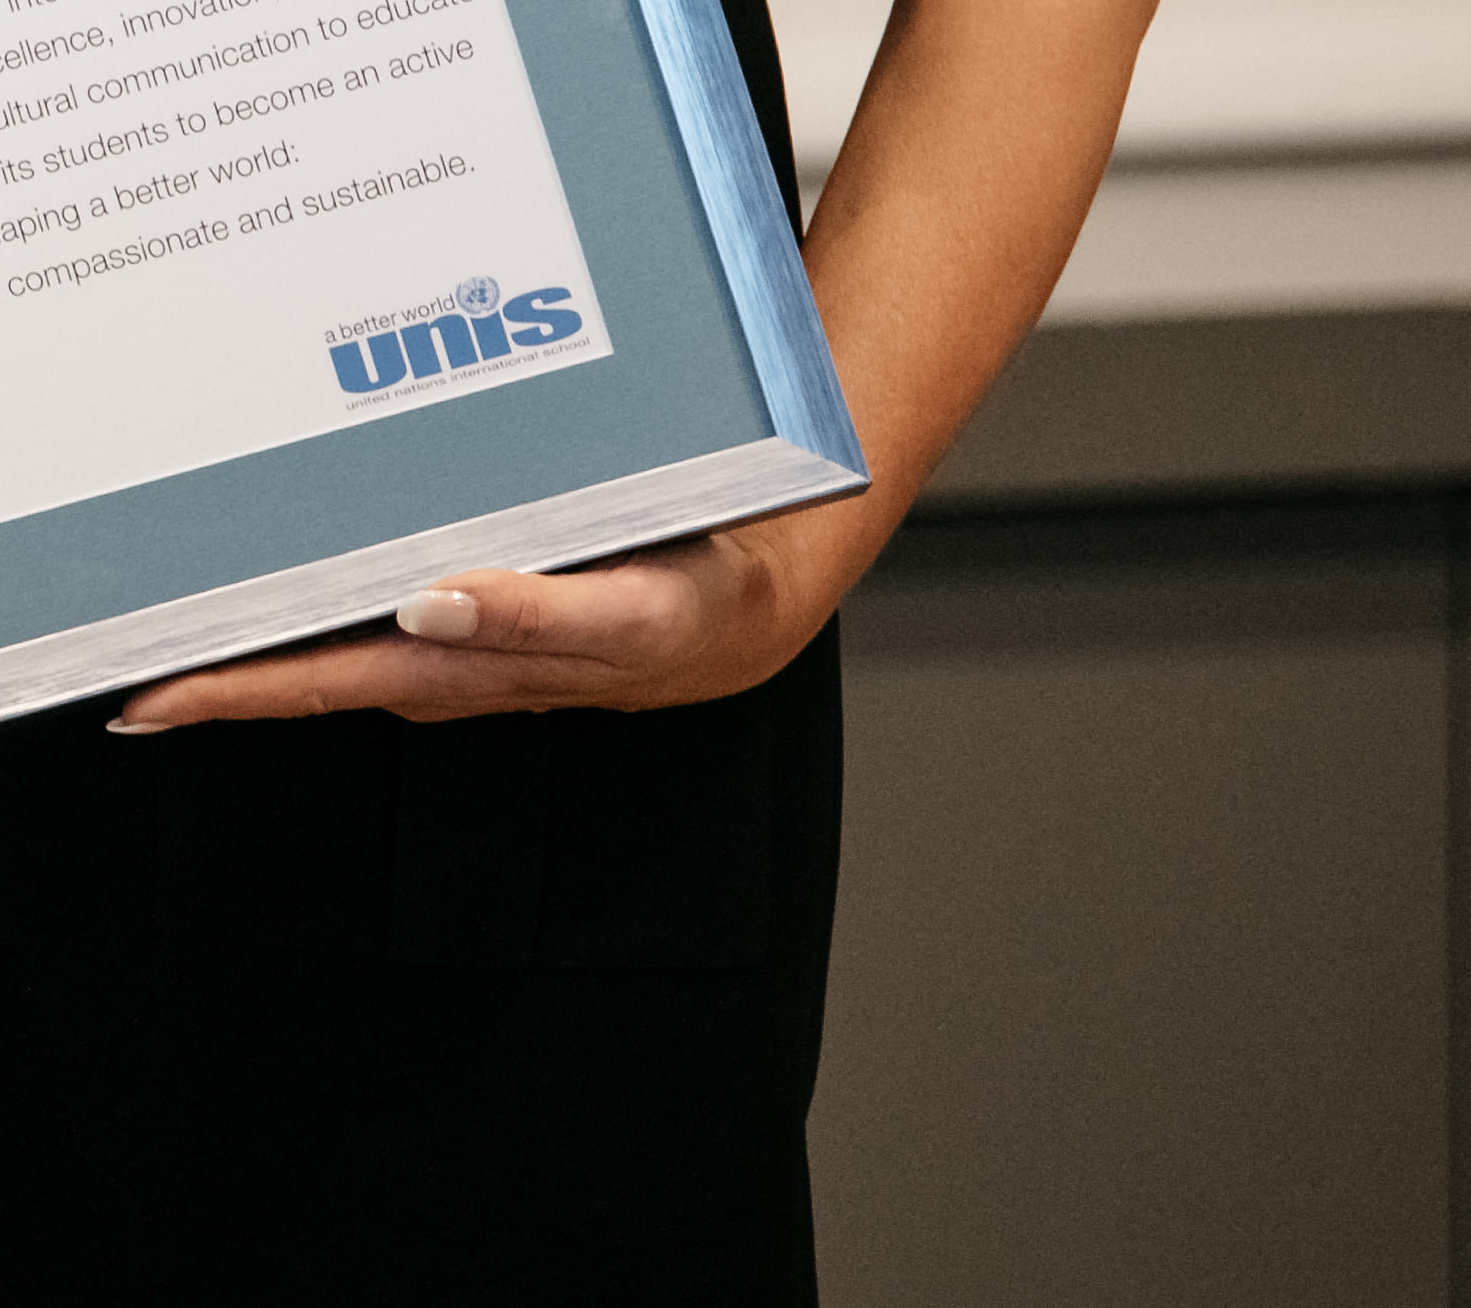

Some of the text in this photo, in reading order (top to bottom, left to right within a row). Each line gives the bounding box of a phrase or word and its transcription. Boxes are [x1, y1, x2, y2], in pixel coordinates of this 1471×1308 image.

[87, 27, 310, 104] communication
[317, 17, 348, 41] to
[0, 160, 35, 185] its
[42, 123, 170, 173] students
[175, 113, 207, 136] to
[213, 78, 335, 126] become
[343, 65, 380, 91] an
[389, 40, 474, 79] active
[89, 197, 109, 218] a
[113, 170, 199, 210] better
[208, 140, 299, 184] world:
[7, 220, 229, 297] compassionate
[238, 196, 294, 234] and
[302, 153, 475, 216] sustainable.
[323, 293, 457, 344] a better world
[328, 286, 584, 394] unis
[345, 336, 592, 411] united nations international school
